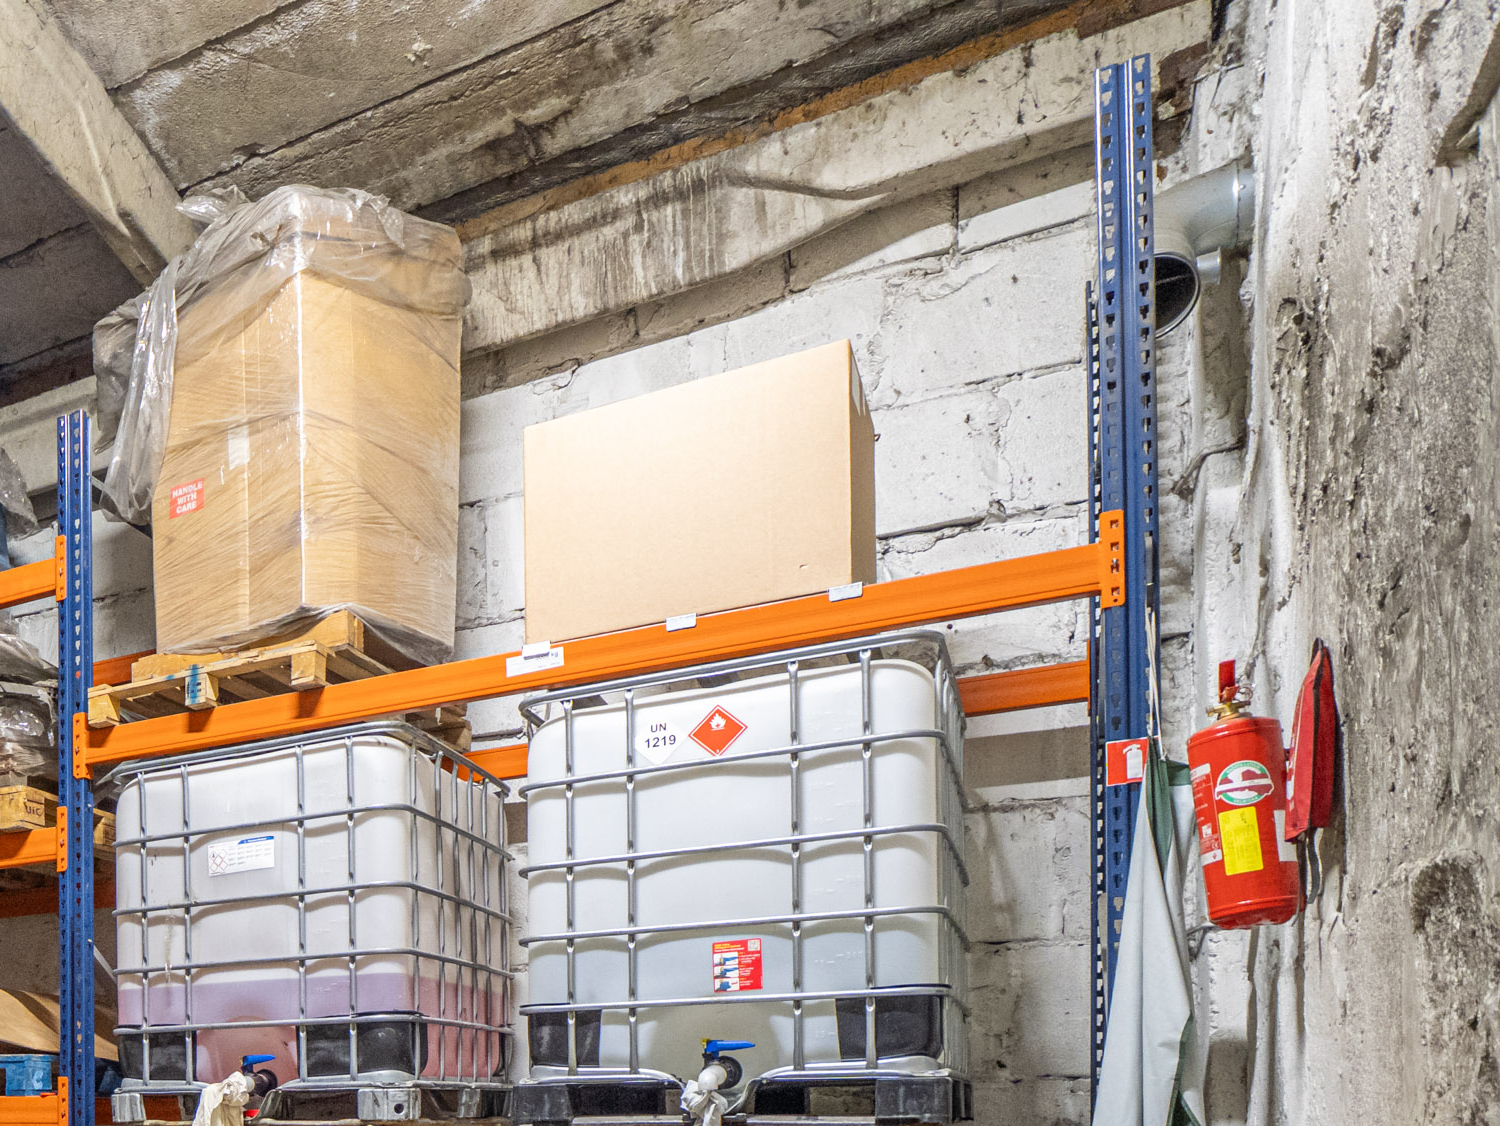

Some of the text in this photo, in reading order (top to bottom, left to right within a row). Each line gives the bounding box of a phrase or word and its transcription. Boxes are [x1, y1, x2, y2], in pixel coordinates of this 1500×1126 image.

[171, 481, 203, 499] HANDLE
[177, 491, 197, 505] WITH
[176, 501, 197, 514] CARE
[650, 723, 667, 733] UN
[644, 734, 676, 748] 1219
